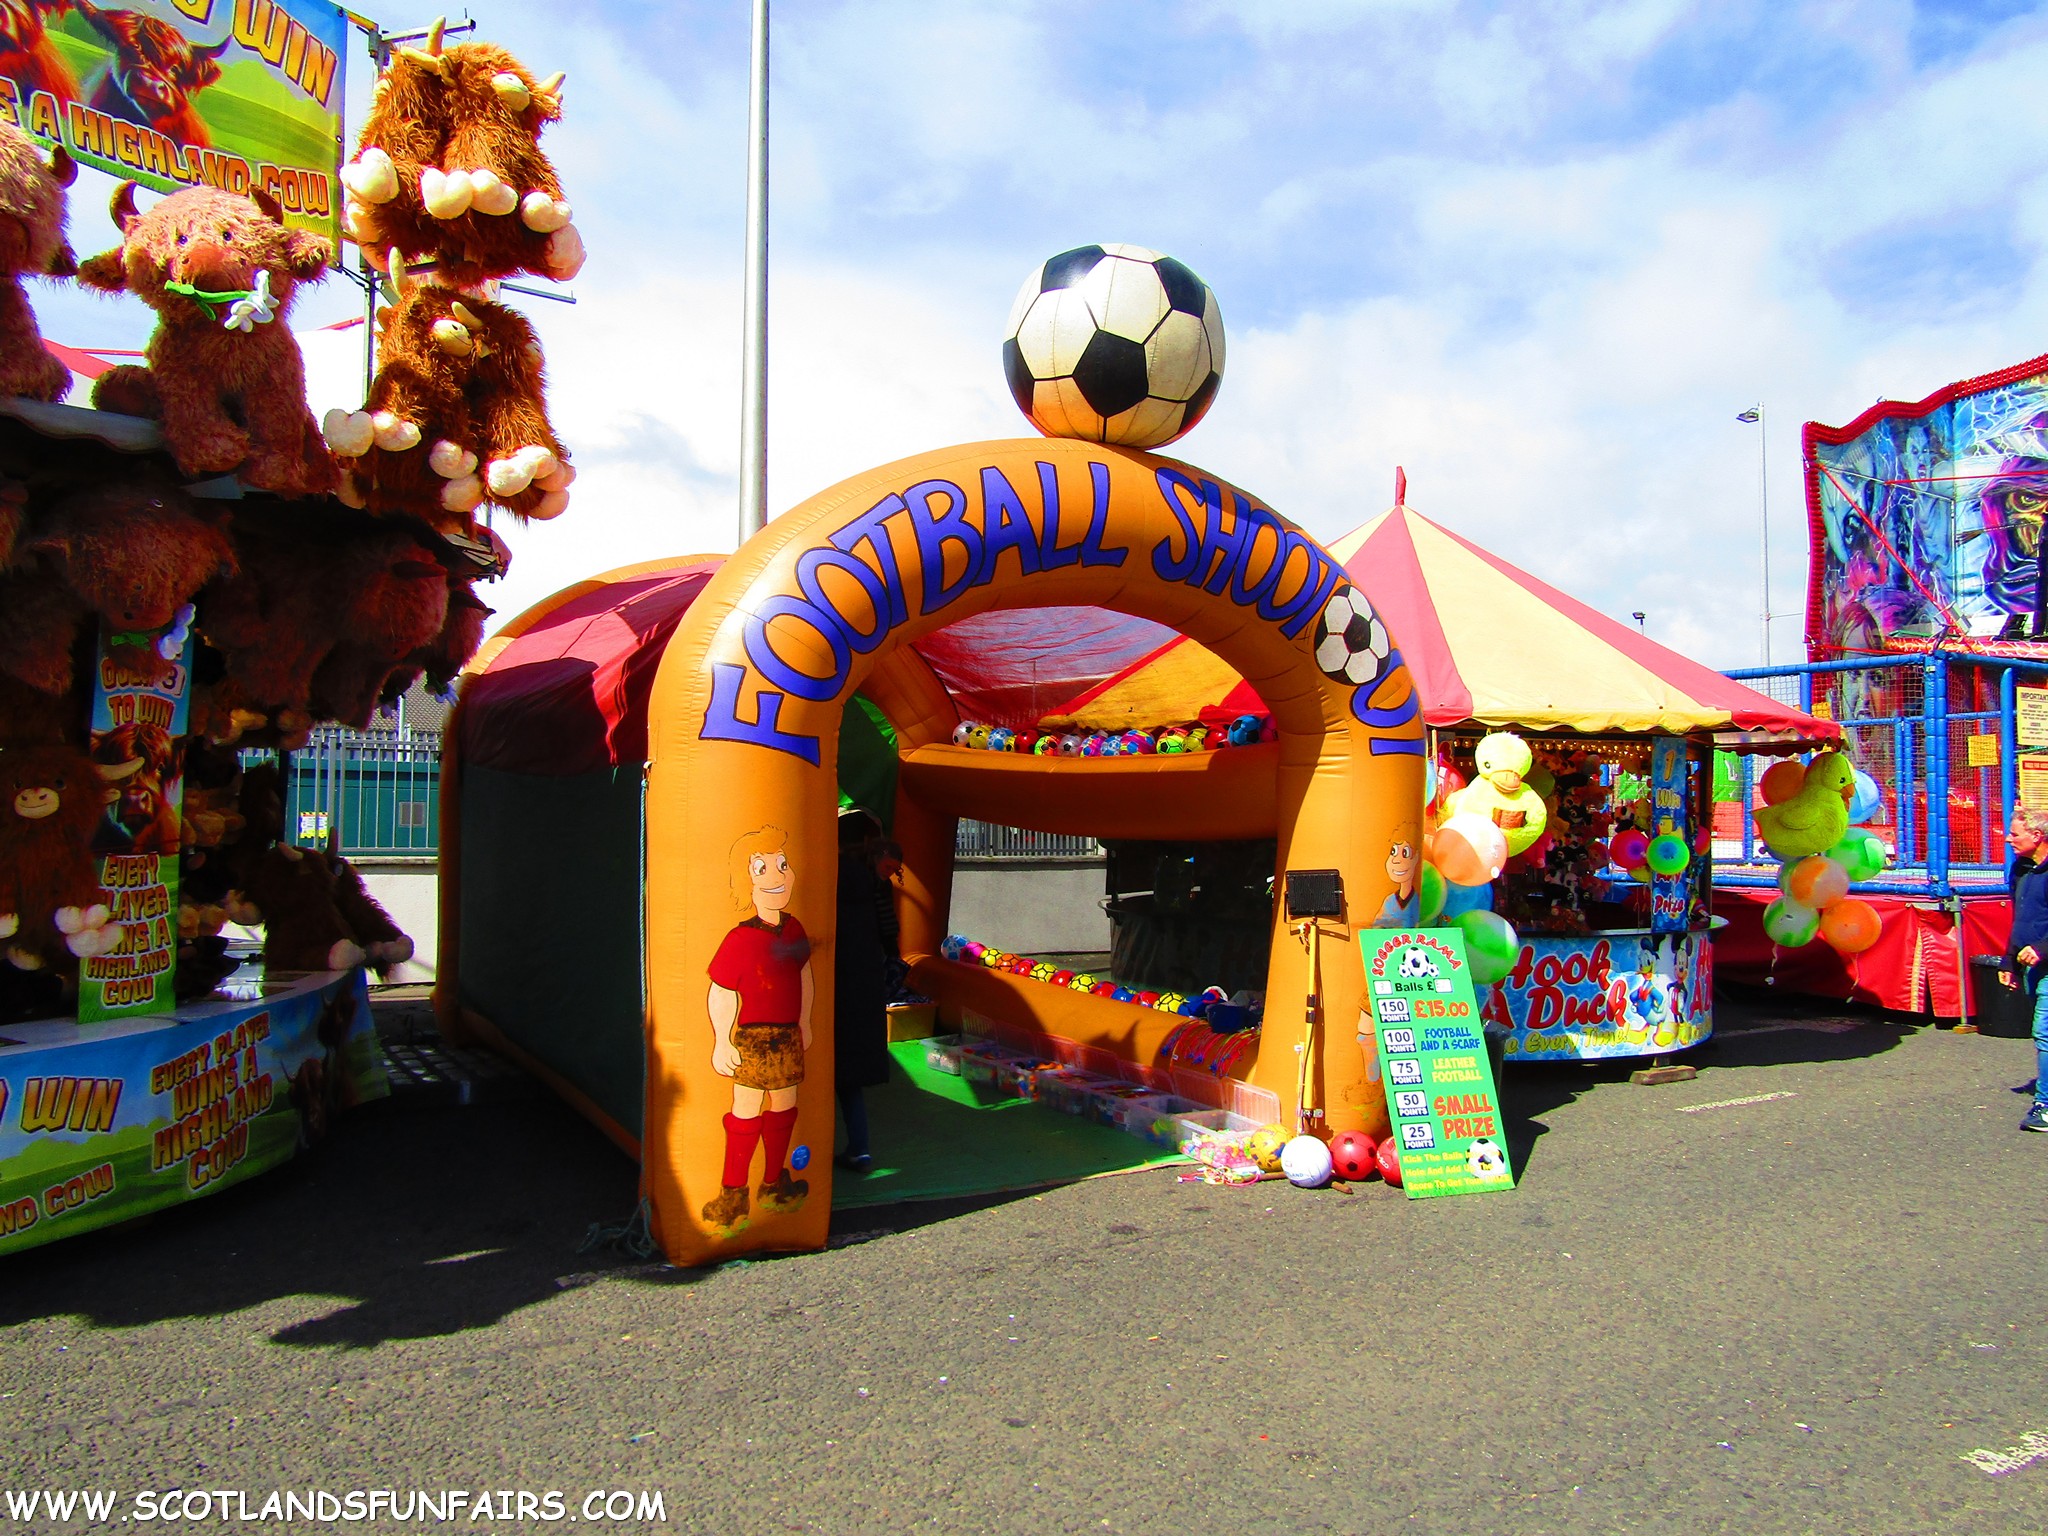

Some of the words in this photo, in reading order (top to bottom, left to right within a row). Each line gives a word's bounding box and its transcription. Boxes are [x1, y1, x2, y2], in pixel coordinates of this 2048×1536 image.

[232, 0, 337, 108] WIN
[31, 92, 63, 143] A
[69, 103, 251, 196] HIGHLAND
[259, 165, 331, 217] COW
[698, 460, 1129, 768] FOOTBALL
[109, 694, 134, 726] TO
[139, 694, 174, 731] WIN
[104, 854, 159, 887] EVERY
[103, 922, 150, 955] NS
[155, 919, 171, 948] A
[88, 949, 170, 979] HIGHLAND
[1372, 933, 1412, 976] SOCCER
[1416, 933, 1462, 970] RAMA
[1493, 940, 1611, 991] Hook
[104, 975, 154, 1005] COW
[1395, 982, 1424, 992] Balls
[1381, 1001, 1405, 1012] 150
[1414, 999, 1470, 1018] £15.00
[1381, 1014, 1410, 1022] POINTS
[1481, 988, 1515, 1029] A
[1526, 979, 1627, 1030] Duck
[1387, 1031, 1411, 1043] 100
[1424, 1027, 1472, 1039] FOOTBALL
[1387, 1045, 1416, 1053] POINTS
[1421, 1040, 1440, 1051] AND
[1442, 1040, 1450, 1050] A
[1451, 1038, 1481, 1050] SCARF
[1523, 1032, 1580, 1054] Every
[1582, 1022, 1631, 1048] Time!
[152, 1043, 210, 1095] EVERY
[214, 1012, 270, 1064] PLAYER
[1397, 1062, 1414, 1074] 75
[1432, 1056, 1477, 1070] LEATHER
[174, 1056, 238, 1121] WINS
[243, 1043, 258, 1083] A
[1393, 1075, 1422, 1084] POINTS
[1432, 1069, 1483, 1083] FOOTBALL
[20, 1076, 124, 1134] WIN
[1403, 1094, 1419, 1106] 50
[1432, 1093, 1494, 1118] SMALL
[153, 1073, 273, 1170] HIGHLAND
[1399, 1107, 1429, 1117] POINTS
[1442, 1116, 1497, 1141] PRIZE
[1409, 1126, 1426, 1138] 25
[188, 1123, 249, 1190] COW
[1402, 1154, 1423, 1164] Kick
[1424, 1153, 1441, 1162] The
[1405, 1139, 1435, 1149] POINTS
[43, 1163, 115, 1217] COW
